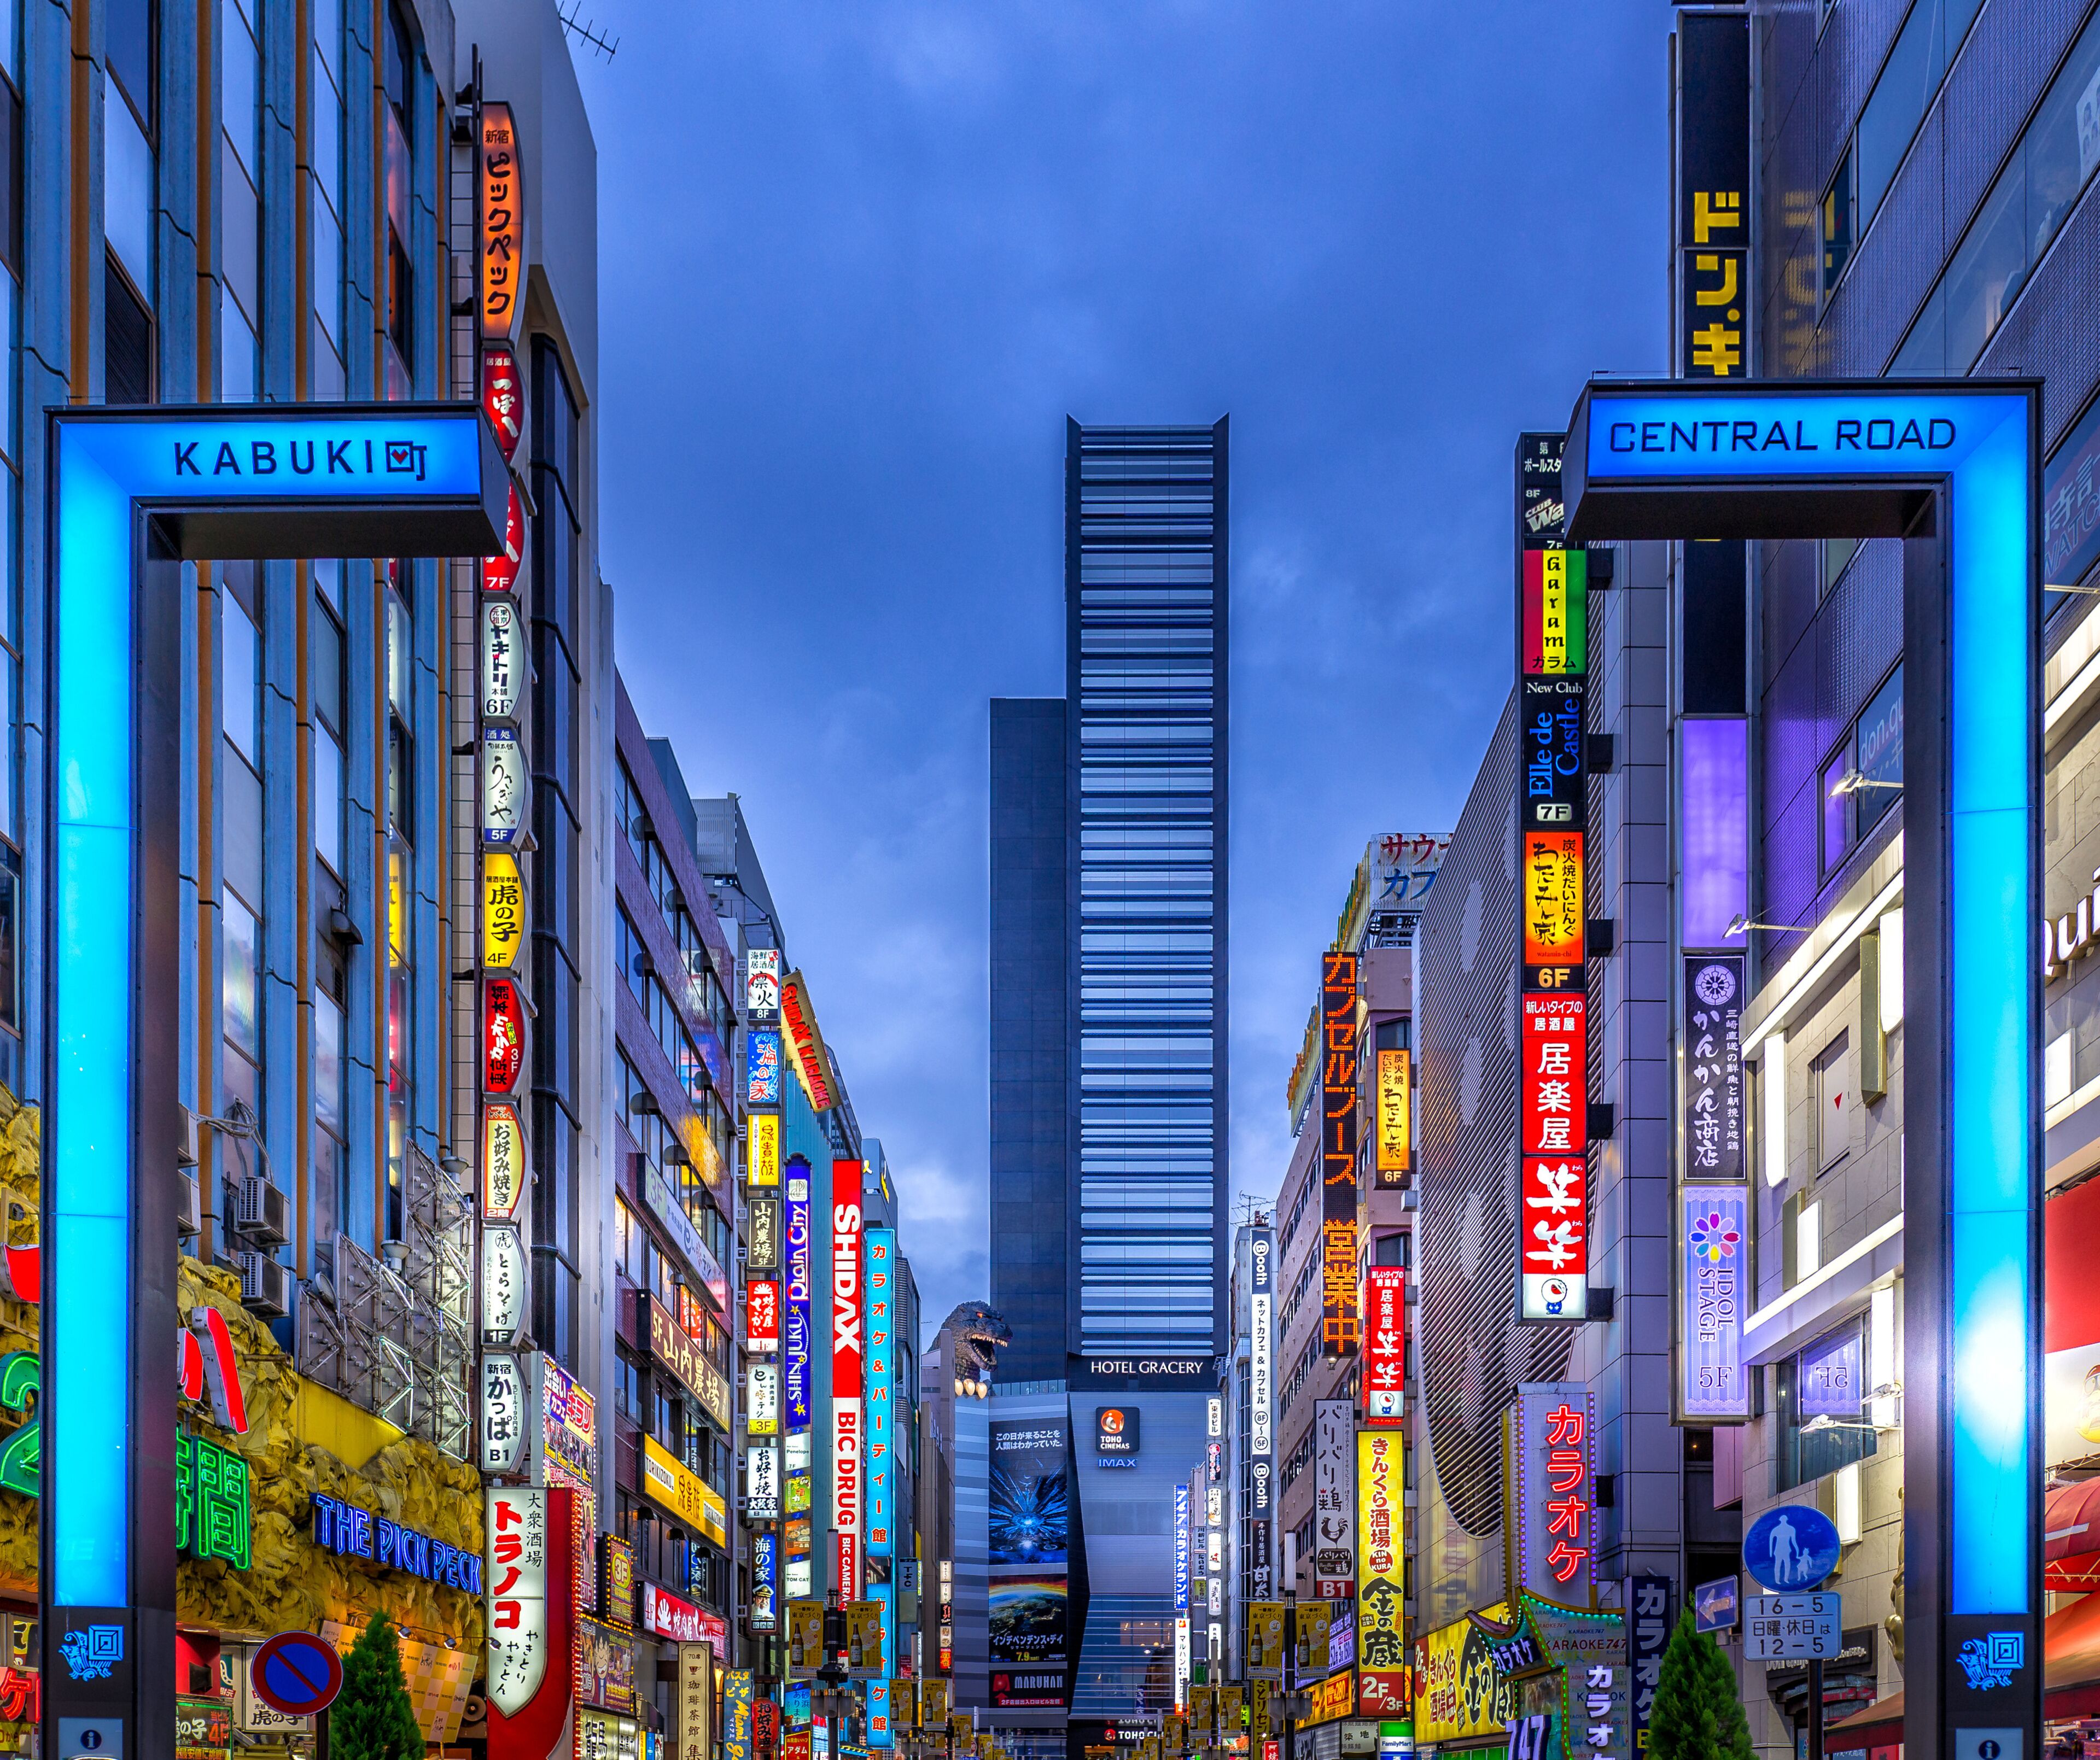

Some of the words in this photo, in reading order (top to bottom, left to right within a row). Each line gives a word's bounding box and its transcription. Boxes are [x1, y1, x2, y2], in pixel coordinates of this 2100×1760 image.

[485, 129, 509, 144] 新宿
[1609, 419, 1819, 452] CENTRAL
[1835, 418, 1957, 450] ROAD
[1525, 498, 1552, 518] CLUB
[1547, 541, 1563, 549] 7F
[487, 577, 509, 588] 7F
[1544, 557, 1565, 647] Garam
[491, 624, 509, 687] ヤキトリ
[1532, 657, 1577, 669] ガラム
[1526, 682, 1553, 693] New
[1555, 682, 1583, 693] Club
[486, 699, 512, 714] 6F
[487, 730, 511, 739] 酒処
[1529, 712, 1553, 745] de
[1555, 698, 1580, 776] Castle
[1529, 749, 1553, 798] Elle
[1540, 806, 1569, 820] 7F
[492, 830, 508, 840] 5F
[1532, 841, 1559, 946] わたみん家
[1562, 839, 1576, 936] 炭火焼だいにんぐ
[488, 885, 518, 942] 虎の子
[487, 953, 507, 963] 4F
[751, 951, 767, 960] 海鮮
[751, 961, 775, 969] 居酒屋
[1538, 968, 1571, 988] 6F
[757, 1009, 769, 1019] 8F
[1525, 999, 1583, 1015] 新しいタイプの
[1535, 1017, 1576, 1032] 居酒屋
[511, 1048, 519, 1073] 3F
[781, 983, 813, 1046] SHIDAX
[797, 1044, 832, 1109] KARAOKE
[750, 1044, 777, 1101] 海の家
[1325, 952, 1356, 1185] カプセルブース
[1382, 1054, 1392, 1085] だいにんぐ
[1394, 1054, 1403, 1085] 炭火焼
[1537, 1042, 1572, 1150] 居楽屋
[1693, 1010, 1721, 1167] かんかん商店
[493, 1124, 510, 1206] お好み焼き
[1385, 1171, 1402, 1182] 6F
[1252, 1239, 1269, 1285] Booth
[1372, 1270, 1404, 1279] 新しいタイプの
[834, 1203, 861, 1355] SHIDAX
[872, 1244, 886, 1345] カラオケ
[1323, 1219, 1358, 1353] 営業中
[762, 1294, 774, 1328] 焼肉屋
[1380, 1289, 1393, 1329] 居楽屋
[1698, 1267, 1717, 1343] STAGE
[1717, 1267, 1735, 1330] IDOL
[652, 1310, 663, 1343] 5F
[750, 1297, 763, 1336] さかい
[1257, 1299, 1265, 1352] ネットカフェ
[489, 1331, 509, 1342] 1F
[756, 1340, 770, 1350] 4F
[487, 1364, 511, 1374] 新宿
[1091, 1361, 1136, 1373] HOTEL
[1139, 1361, 1203, 1374] GRACERY
[1699, 1366, 1733, 1388] 5F
[1257, 1369, 1265, 1405] カプセル
[487, 1376, 513, 1441] かっぱ
[567, 1390, 593, 1434] キラリ
[756, 1422, 771, 1431] 3F
[838, 1412, 856, 1452] BIC
[996, 1430, 1060, 1441] この日が来ることを
[489, 1449, 509, 1461] B1
[995, 1439, 1063, 1450] 人類はわかっていた。
[872, 1386, 886, 1543] パーティー館
[1098, 1458, 1137, 1467] IMAX
[838, 1459, 856, 1526] DRUG
[1253, 1463, 1270, 1508] Booth
[1369, 1437, 1393, 1548] きんくら酒場
[1546, 1404, 1589, 1584] カラオケ
[749, 1499, 777, 1510] 大阪家
[310, 1492, 372, 1559] THE
[372, 1516, 430, 1580] PICK
[429, 1538, 483, 1597] PECK
[526, 1492, 544, 1568] 大衆酒場
[842, 1537, 851, 1555] BIC
[493, 1501, 523, 1629] トラノコ
[614, 1558, 628, 1583] 3F
[755, 1537, 771, 1581] 海の家
[1371, 1563, 1392, 1571] KURA
[842, 1557, 851, 1601] CAMERA
[1322, 1581, 1345, 1597] B1
[645, 1593, 655, 1621] 4F
[1361, 1576, 1403, 1668] 金の蔵
[1016, 1652, 1030, 1661] 7.9
[1429, 1647, 1457, 1687] きんくら
[1492, 1638, 1536, 1672] カラオケ
[726, 1670, 749, 1681] パスタ
[726, 1686, 749, 1698] ピザ
[1014, 1676, 1063, 1688] MARUHAN
[1362, 1676, 1390, 1699] 2F
[687, 1680, 701, 1738] 珈琲茶館
[734, 1699, 749, 1742] Miami
[1430, 1687, 1446, 1724] 酒場
[1118, 1730, 1145, 1740] TOHO
